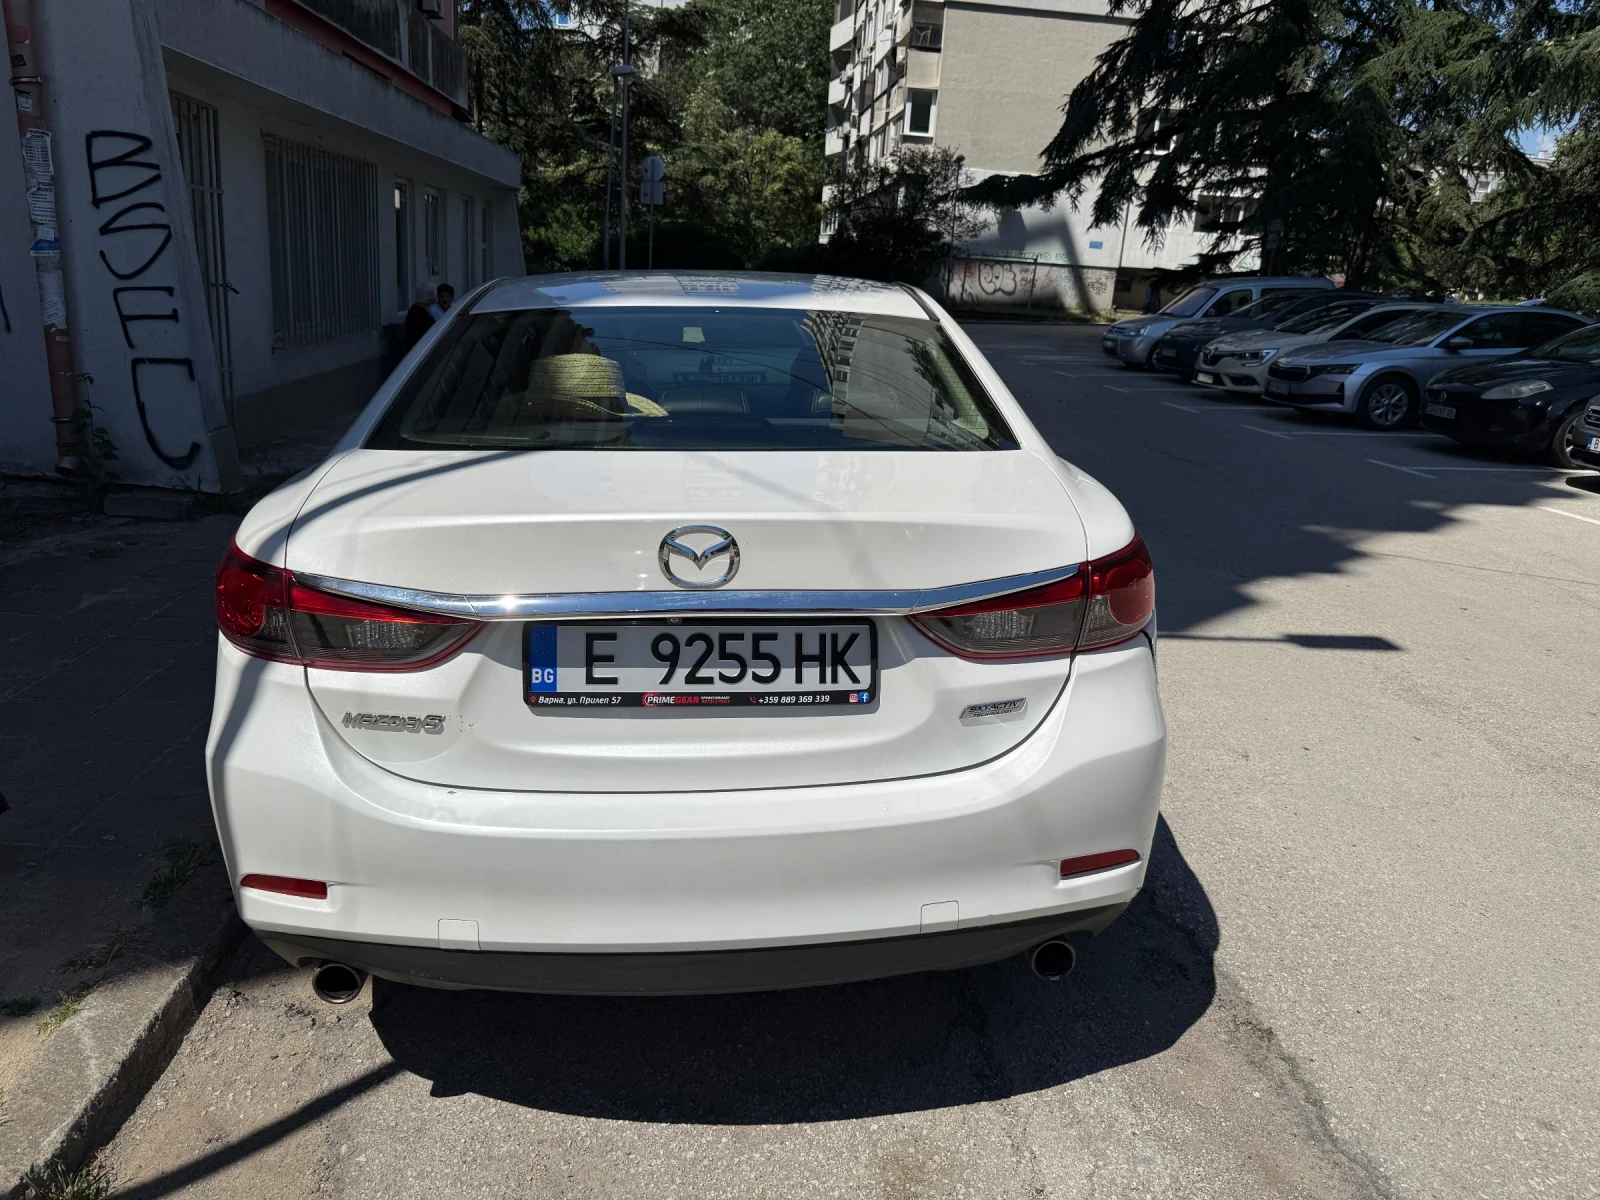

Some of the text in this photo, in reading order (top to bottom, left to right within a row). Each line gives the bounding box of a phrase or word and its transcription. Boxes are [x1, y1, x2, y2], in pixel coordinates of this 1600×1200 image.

[585, 633, 861, 685] E 9255 HK
[532, 669, 554, 683] BG
[538, 696, 622, 705] Варна, ул. Прилеп 57
[647, 696, 699, 704] PRIMEGEAR
[758, 695, 830, 704] +359 889 369 339
[969, 701, 1021, 713] SKYACTIV
